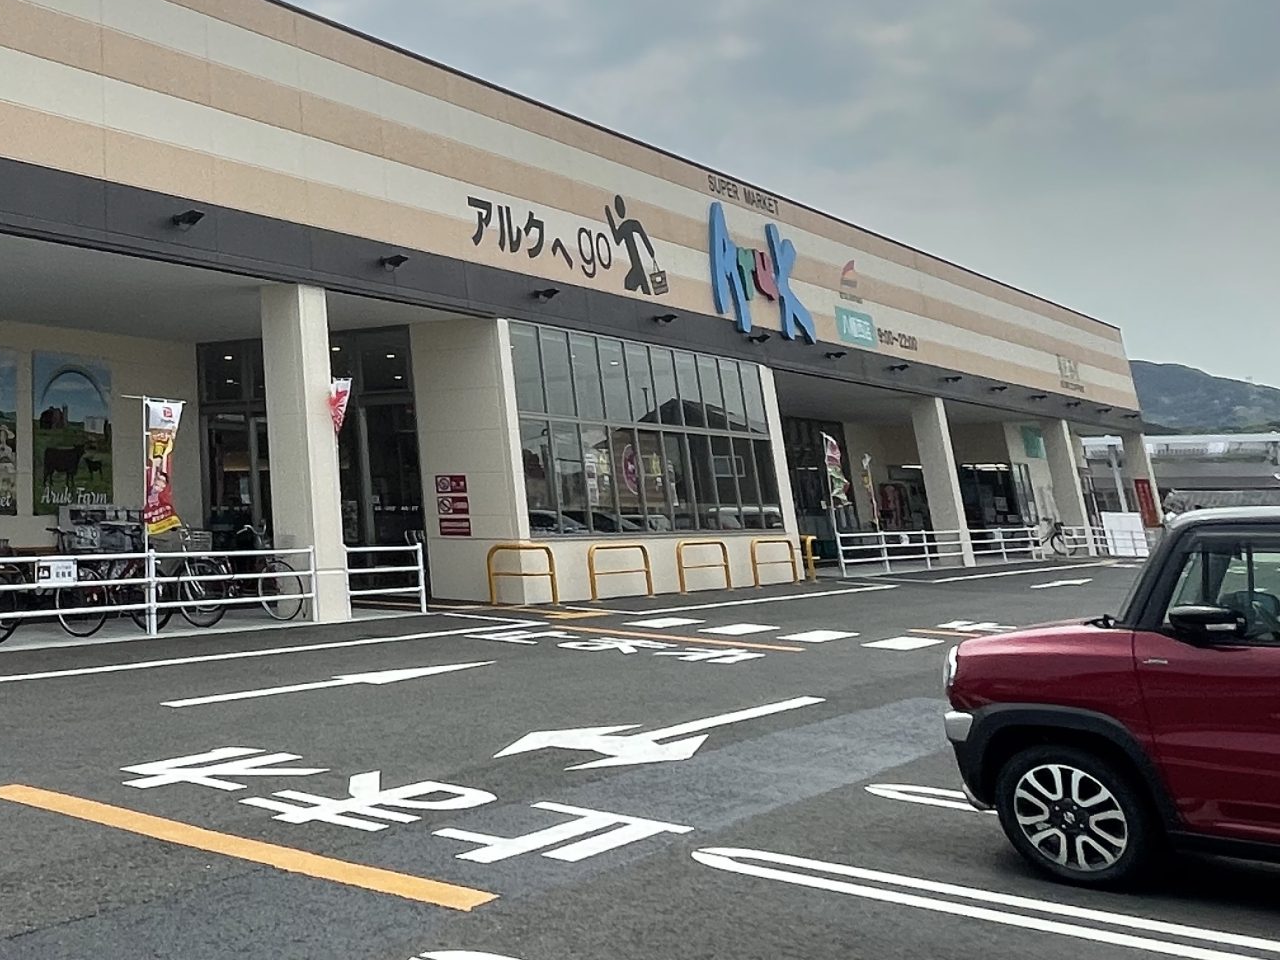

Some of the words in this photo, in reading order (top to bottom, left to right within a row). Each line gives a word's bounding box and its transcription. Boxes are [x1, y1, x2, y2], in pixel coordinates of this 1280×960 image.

[708, 174, 740, 201] SUPER
[744, 187, 780, 216] MARKET
[40, 486, 73, 504] Aruk
[76, 487, 107, 505] Farm
[463, 630, 767, 664] 止まれ
[119, 746, 696, 864] 止まれ
